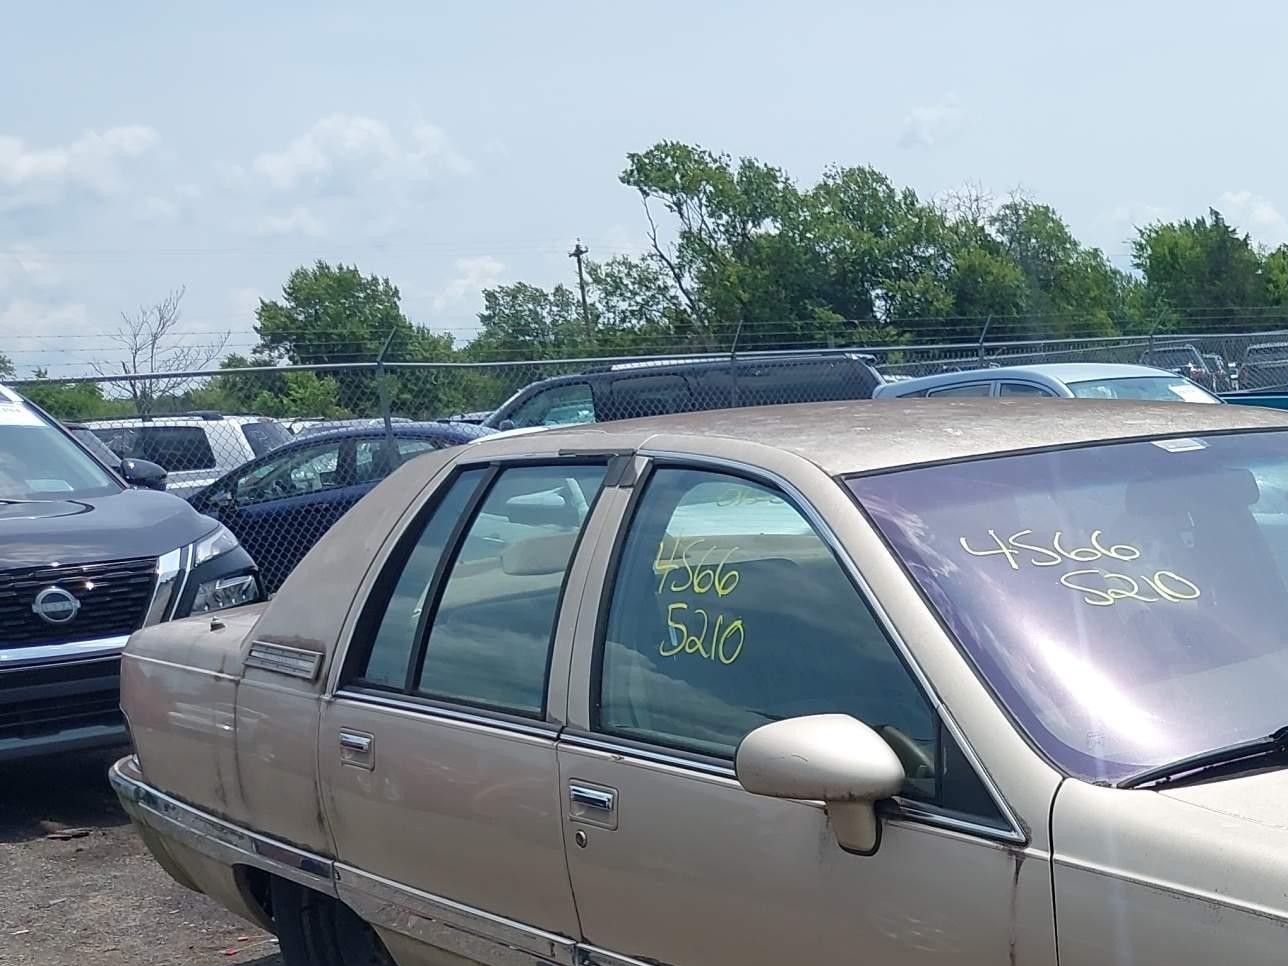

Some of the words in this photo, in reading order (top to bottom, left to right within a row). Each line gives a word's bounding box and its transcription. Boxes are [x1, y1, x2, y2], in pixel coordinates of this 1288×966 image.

[653, 537, 740, 597] 4566
[959, 529, 1141, 570] 4566
[1060, 569, 1201, 606] 5210
[660, 602, 744, 664] 5210
